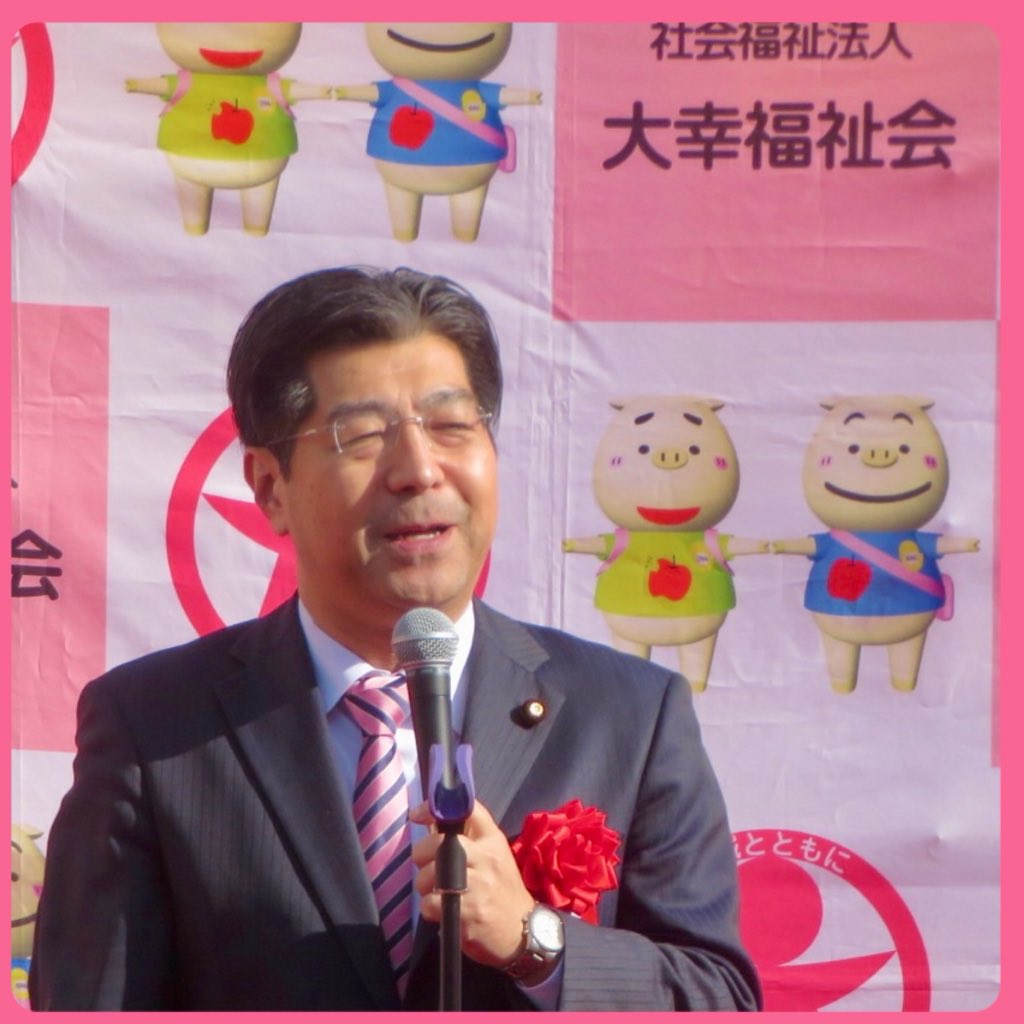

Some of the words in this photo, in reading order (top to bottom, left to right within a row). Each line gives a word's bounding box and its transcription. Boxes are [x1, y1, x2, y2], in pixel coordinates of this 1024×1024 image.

[650, 22, 913, 61] 社会福祉法人
[602, 100, 957, 170] 大幸福祉会
[11, 529, 63, 600] 会
